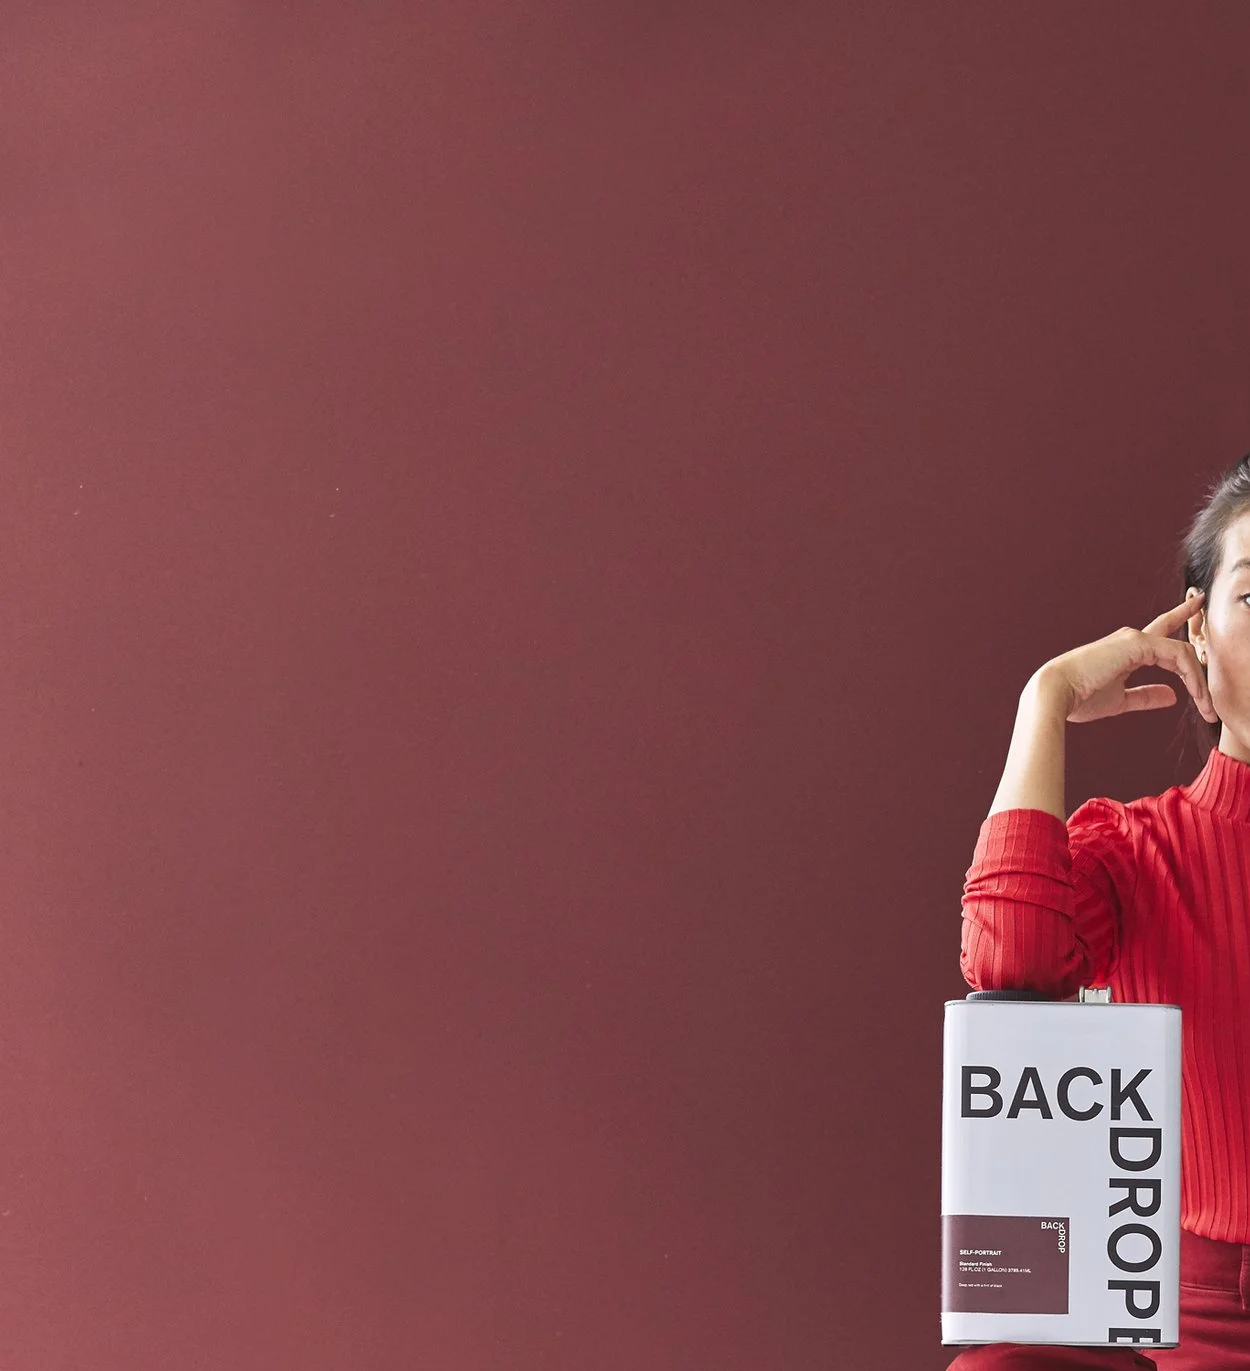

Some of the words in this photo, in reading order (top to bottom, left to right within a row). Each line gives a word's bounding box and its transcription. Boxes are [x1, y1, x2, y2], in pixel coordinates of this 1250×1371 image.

[960, 1065, 1154, 1122] BACK
[1041, 1221, 1065, 1230] BACK
[1058, 1229, 1066, 1254] DROP
